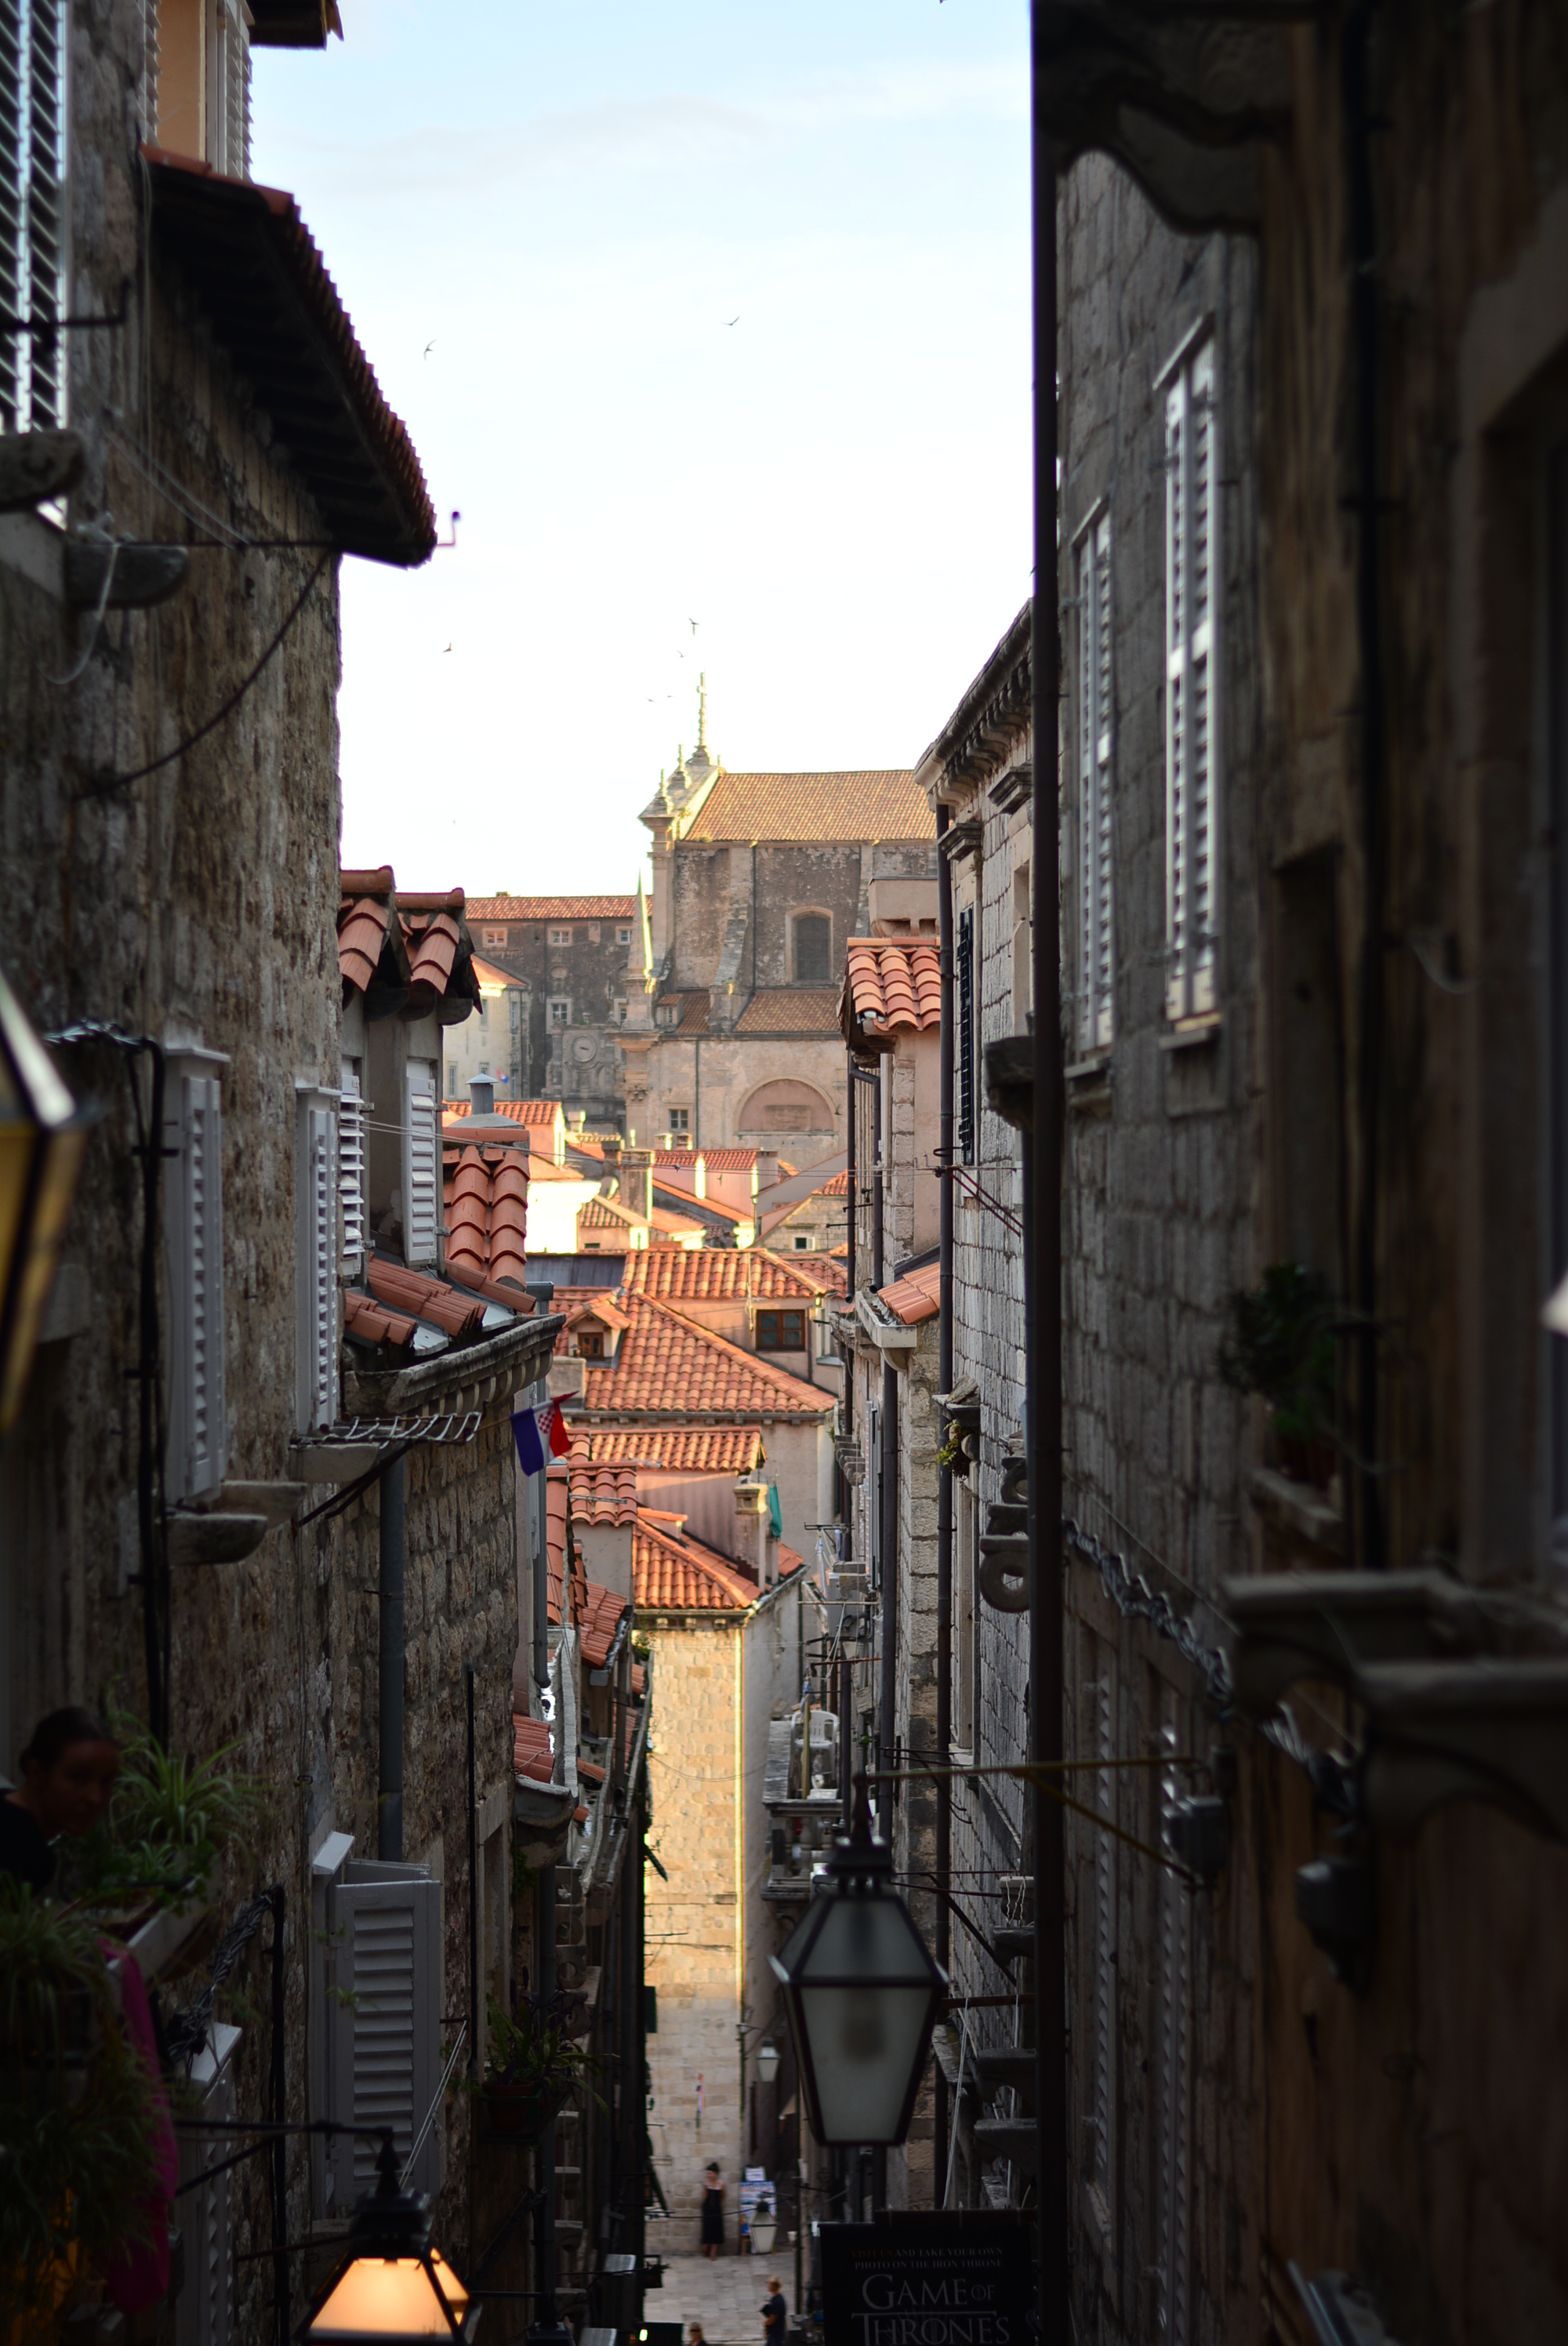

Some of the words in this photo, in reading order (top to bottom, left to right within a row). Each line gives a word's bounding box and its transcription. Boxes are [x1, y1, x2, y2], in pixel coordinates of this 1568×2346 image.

[851, 2250, 877, 2258] VISIT
[880, 2249, 893, 2258] US
[895, 2248, 916, 2257] AND
[918, 2248, 945, 2257] TAKE
[947, 2247, 976, 2256] YOUR
[978, 2247, 1003, 2256] OWN
[855, 2261, 891, 2270] PHOTO
[892, 2260, 907, 2268] ON
[910, 2260, 930, 2268] THE
[932, 2259, 958, 2268] IRON
[961, 2259, 1004, 2268] THRONE
[862, 2274, 968, 2310] GAME
[971, 2284, 996, 2301] OF
[851, 2310, 1011, 2346] THRONES
